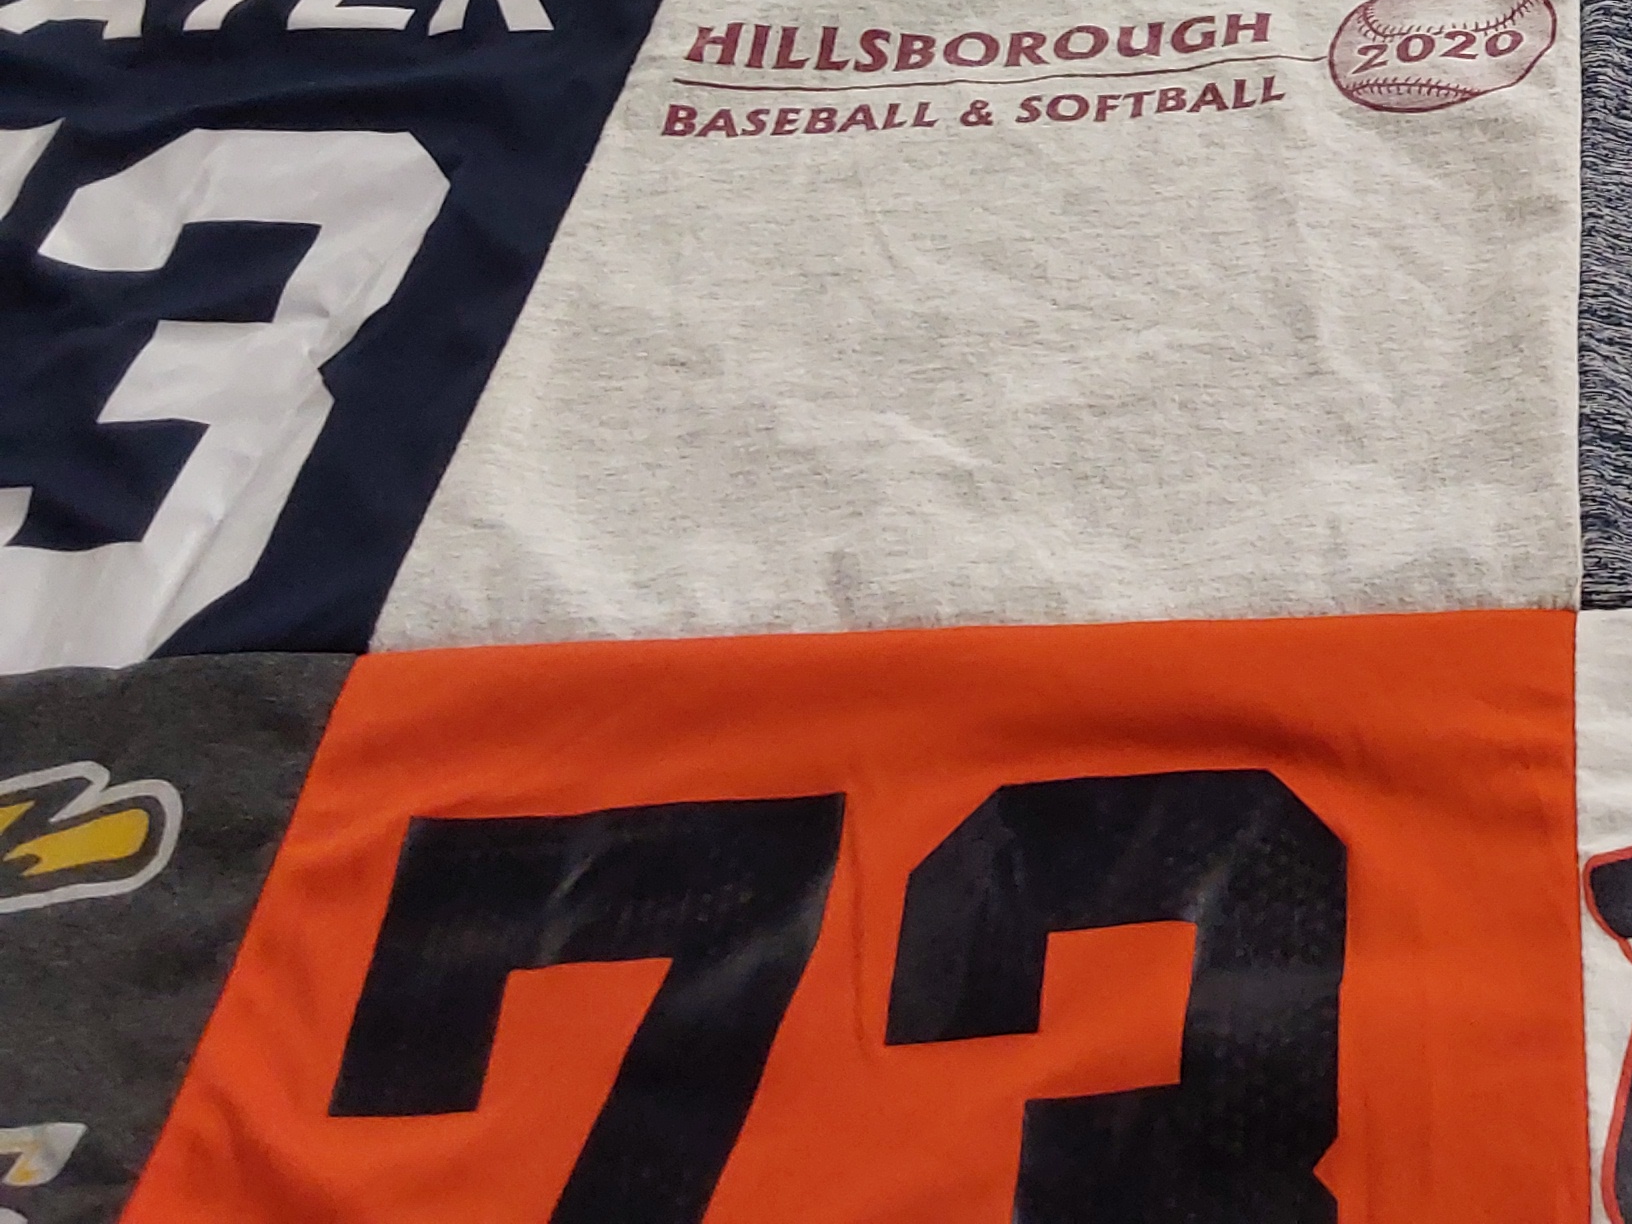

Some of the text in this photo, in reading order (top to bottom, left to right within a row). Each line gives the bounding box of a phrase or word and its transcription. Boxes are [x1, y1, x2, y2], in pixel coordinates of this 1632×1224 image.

[683, 11, 1273, 73] HILLSBOROUGH
[1354, 28, 1526, 78] 2020
[660, 75, 1288, 139] BASEBALL & SOFTBALL
[0, 117, 452, 675] 3
[328, 768, 1348, 1224] 73
